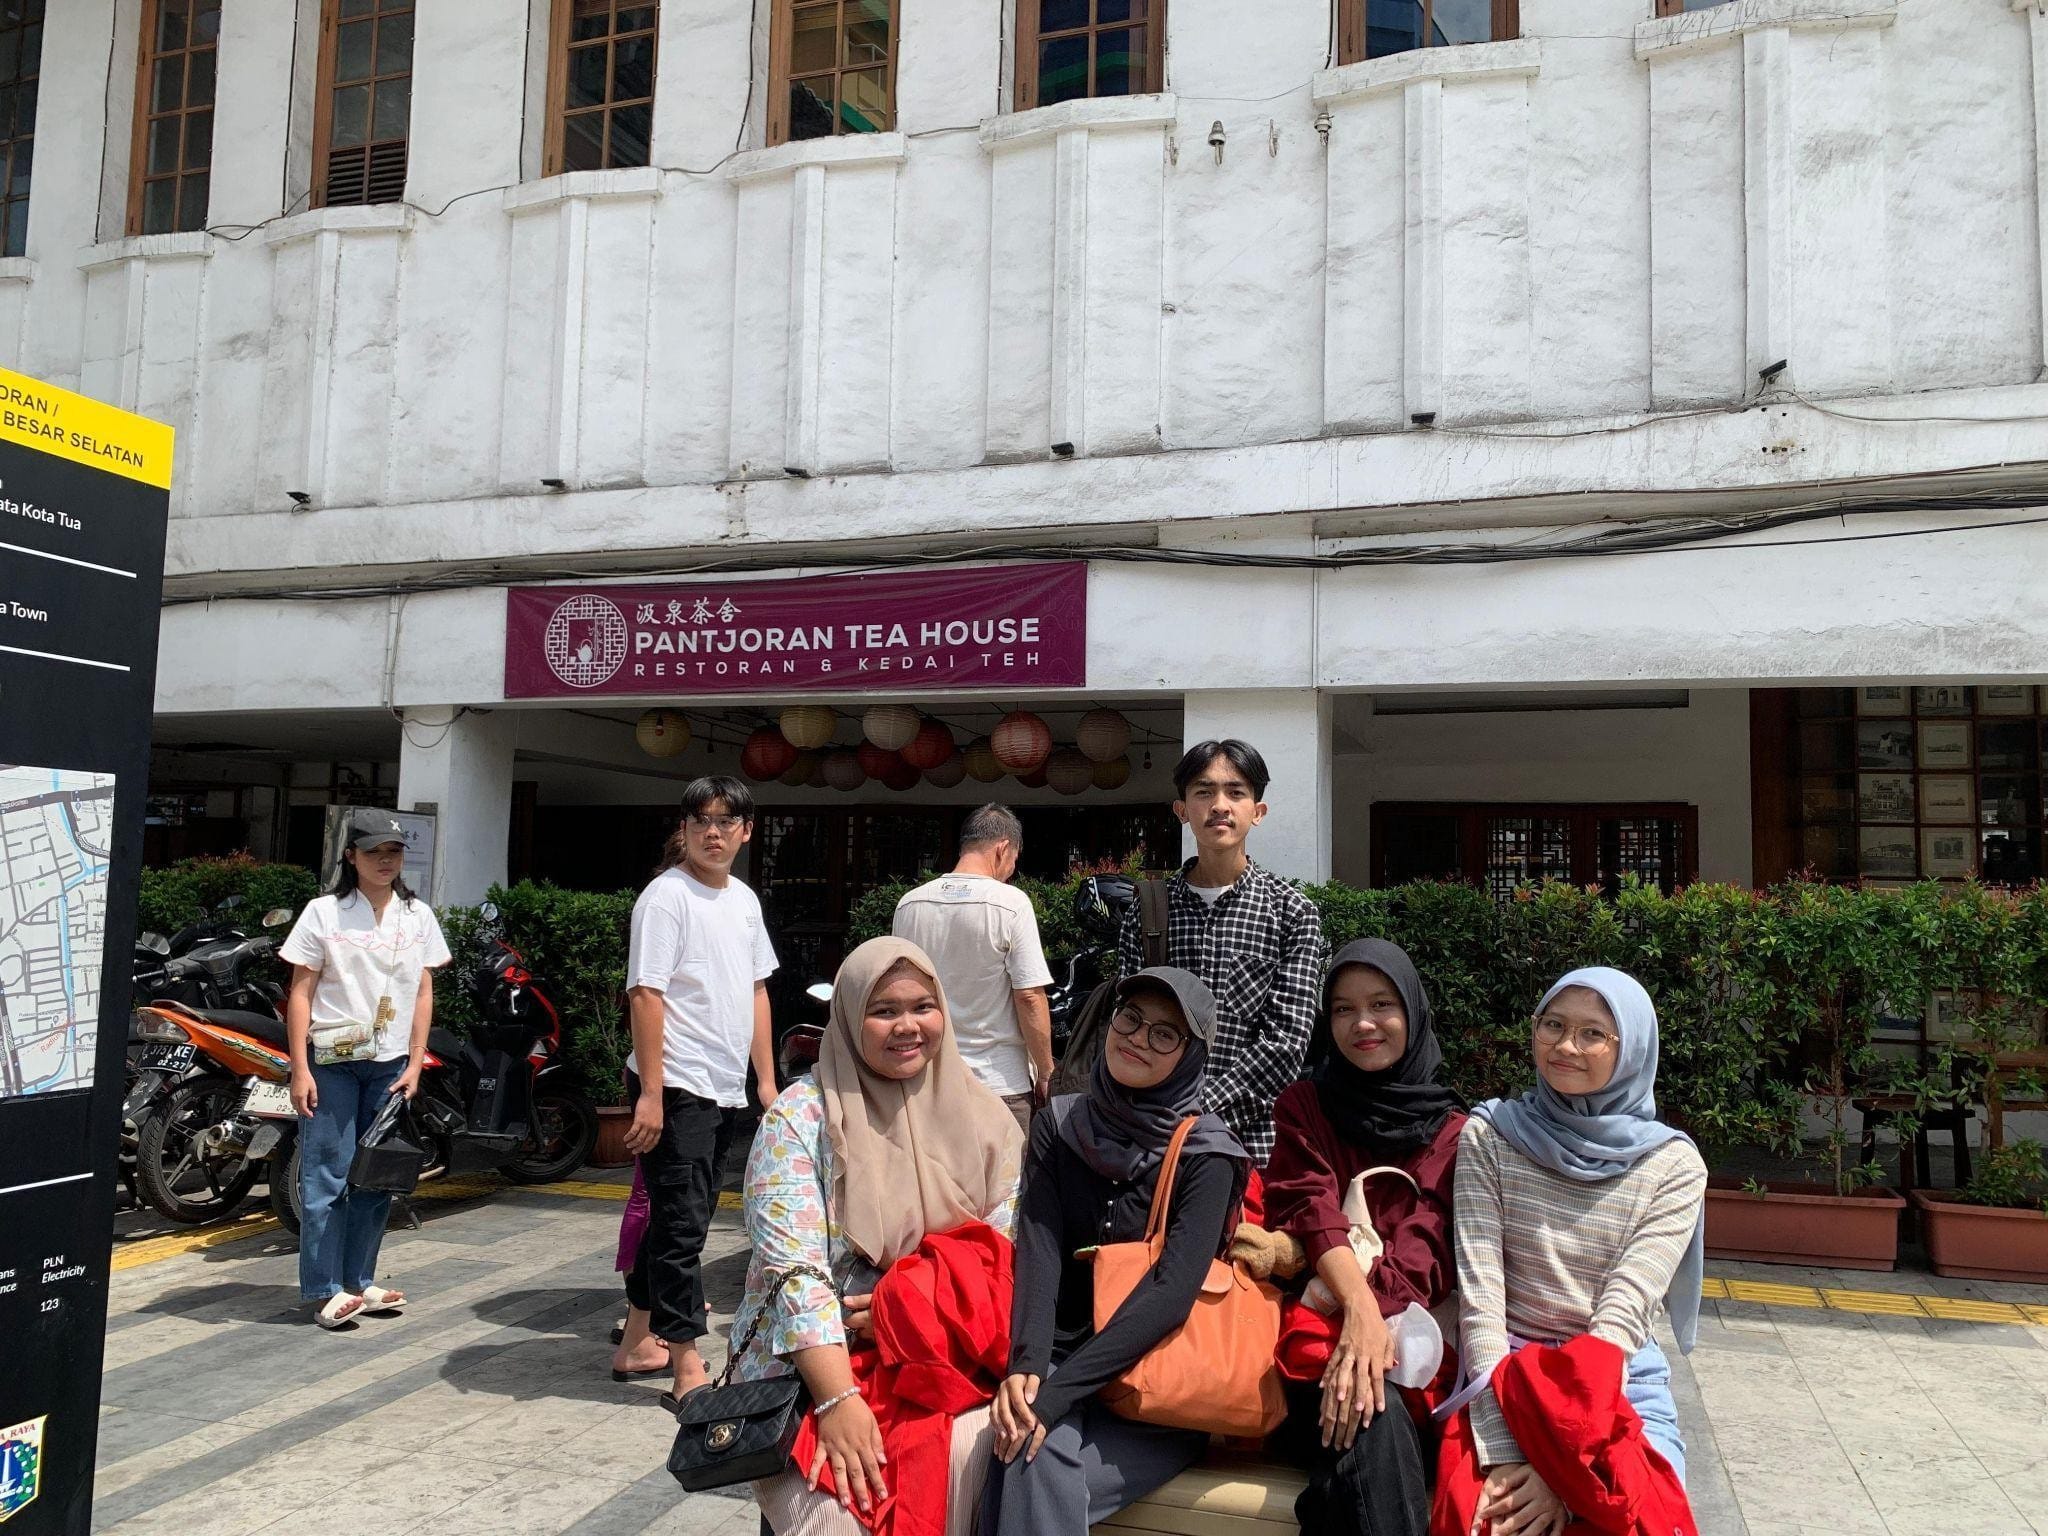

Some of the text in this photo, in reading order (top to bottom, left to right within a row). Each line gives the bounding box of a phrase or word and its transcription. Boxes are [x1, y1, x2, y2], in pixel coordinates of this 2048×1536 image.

[3, 410, 144, 468] BESAR SELATAN
[22, 502, 55, 523] Kota
[57, 511, 82, 530] Tua
[10, 601, 48, 622] Town
[635, 617, 1041, 655] PANTJORAN TEA HOUSE
[634, 652, 1039, 677] RESTORAN & KEDAI TEH
[173, 1045, 192, 1058] KE
[251, 1084, 261, 1097] B
[43, 1255, 64, 1269] PLN
[41, 1265, 86, 1284] Electricity
[40, 1298, 59, 1312] 123
[10, 1423, 36, 1438] RAYA
